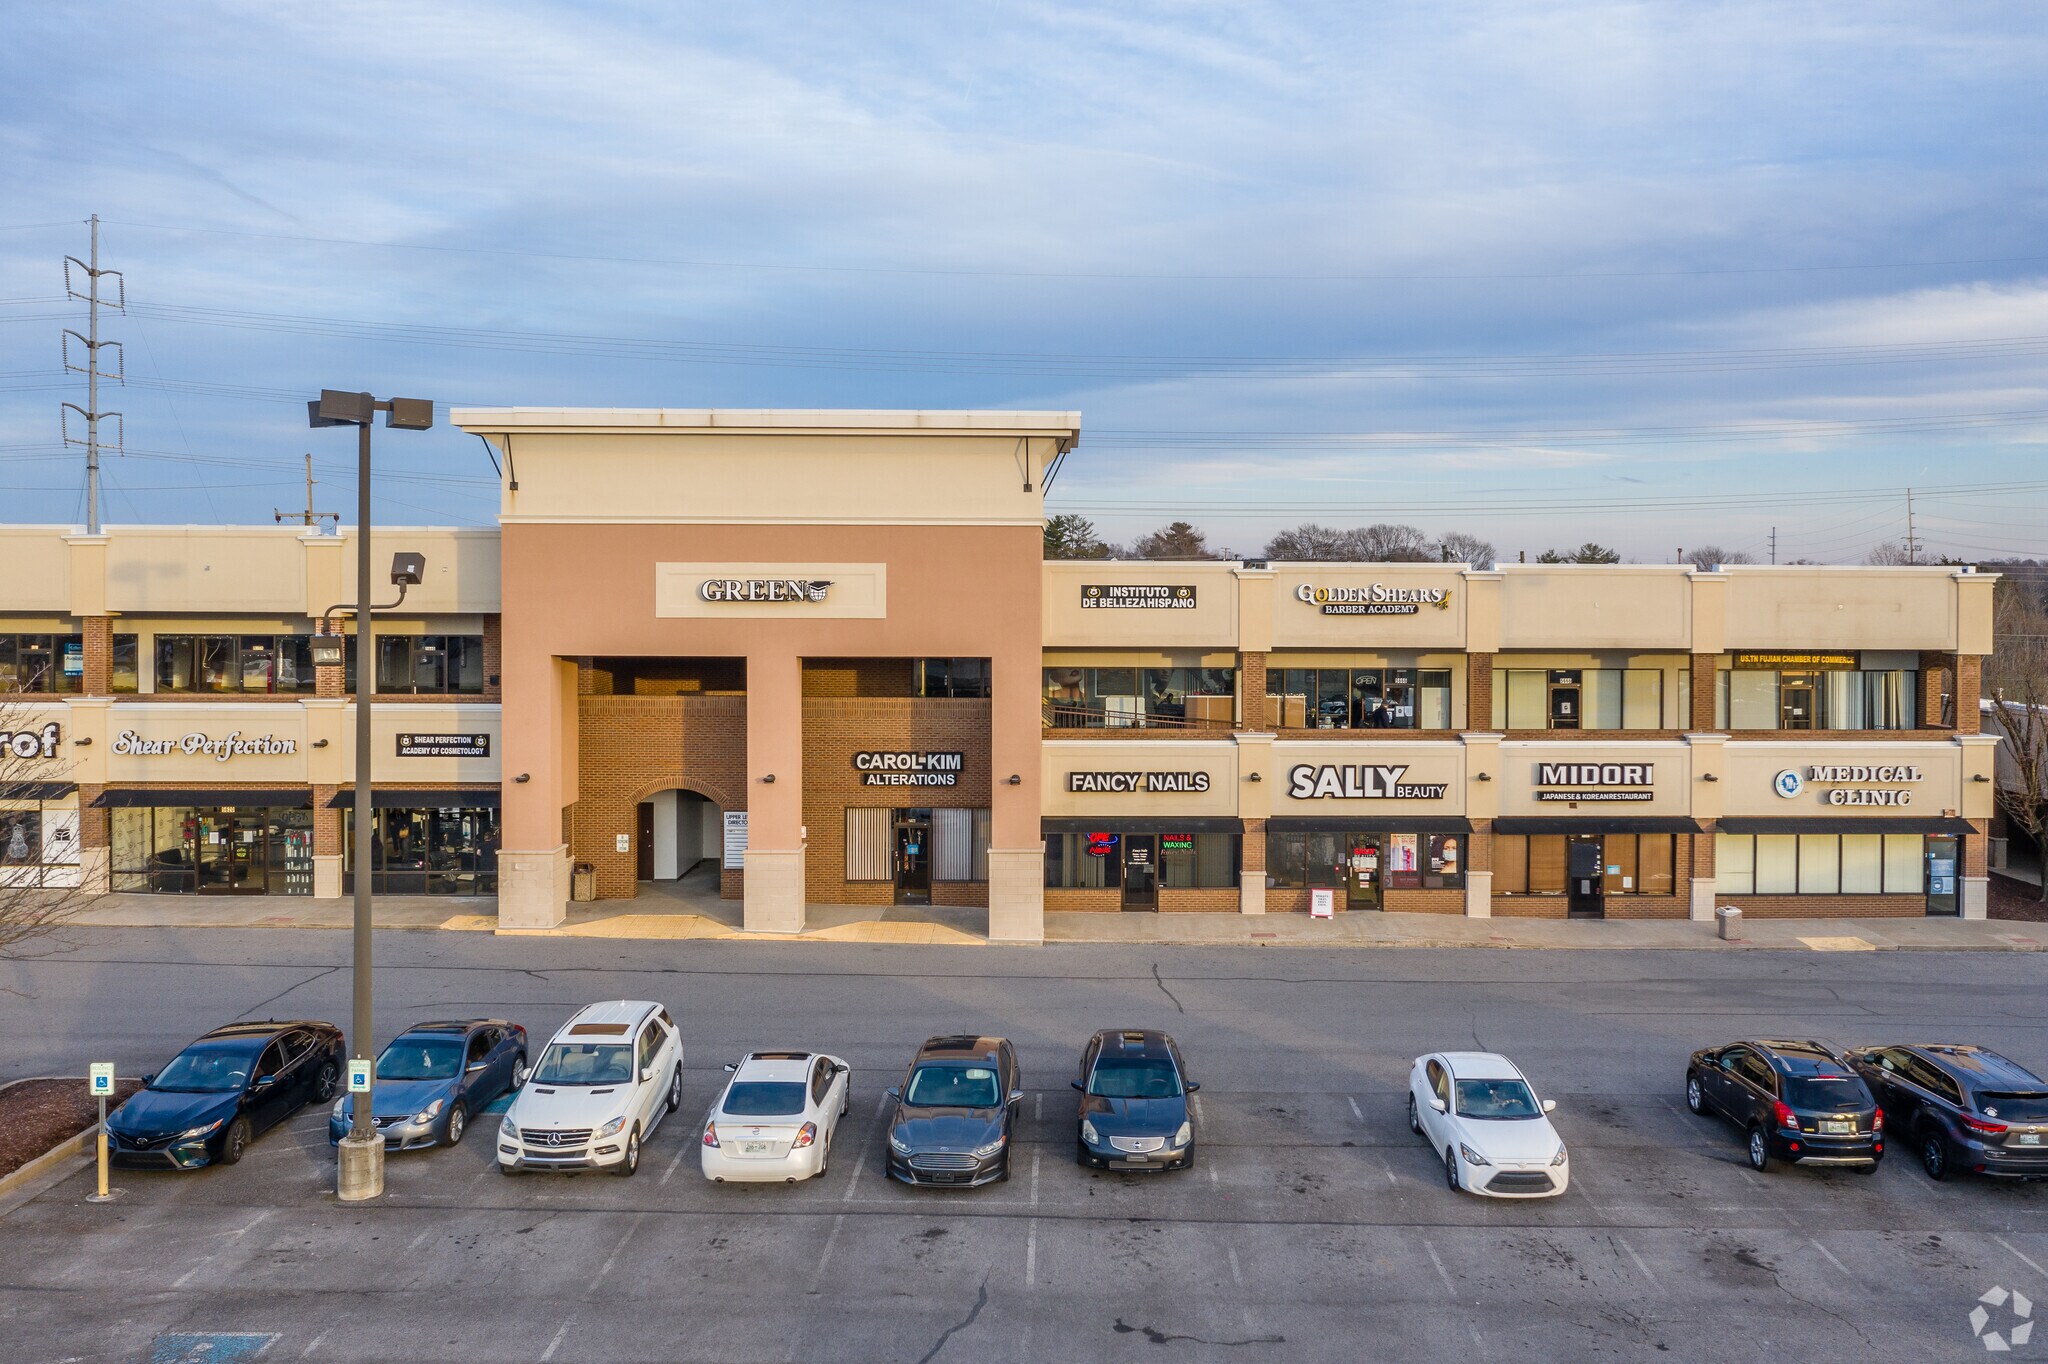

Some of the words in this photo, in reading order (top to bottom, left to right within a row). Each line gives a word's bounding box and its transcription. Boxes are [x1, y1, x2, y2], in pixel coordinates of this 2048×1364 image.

[700, 579, 807, 601] GREEN
[1109, 587, 1169, 597] INSTITUTO
[1298, 583, 1370, 605] GOLDEN
[1371, 583, 1442, 603] SHEARS
[1083, 598, 1097, 608] DE
[1325, 605, 1366, 614] BARBER
[1367, 605, 1415, 614] ACADEMY
[1759, 655, 1781, 663] FUJIAN
[1782, 655, 1811, 663] CHAMBER
[1821, 656, 1855, 664] COMMERCE
[1355, 675, 1377, 685] OPEN
[112, 730, 176, 755] Shear
[180, 731, 297, 762] Perfection
[414, 736, 434, 744] SHEAR
[435, 736, 472, 744] PERFECTION
[402, 747, 430, 755] ACADEMY
[431, 747, 439, 755] OF
[440, 747, 484, 755] COSMETOLOGY
[856, 753, 962, 770] CAROL-KIM
[867, 774, 955, 785] ALTERATIONS
[1542, 765, 1653, 785] MIDORI
[1810, 766, 1924, 782] MEDICAL
[1071, 774, 1139, 791] FANCY
[1149, 774, 1208, 791] NAILS
[1291, 766, 1407, 799] SALLY
[1397, 786, 1445, 798] BEAUTY
[1828, 789, 1912, 806] CLINIC
[1163, 841, 1193, 849] WAXING
